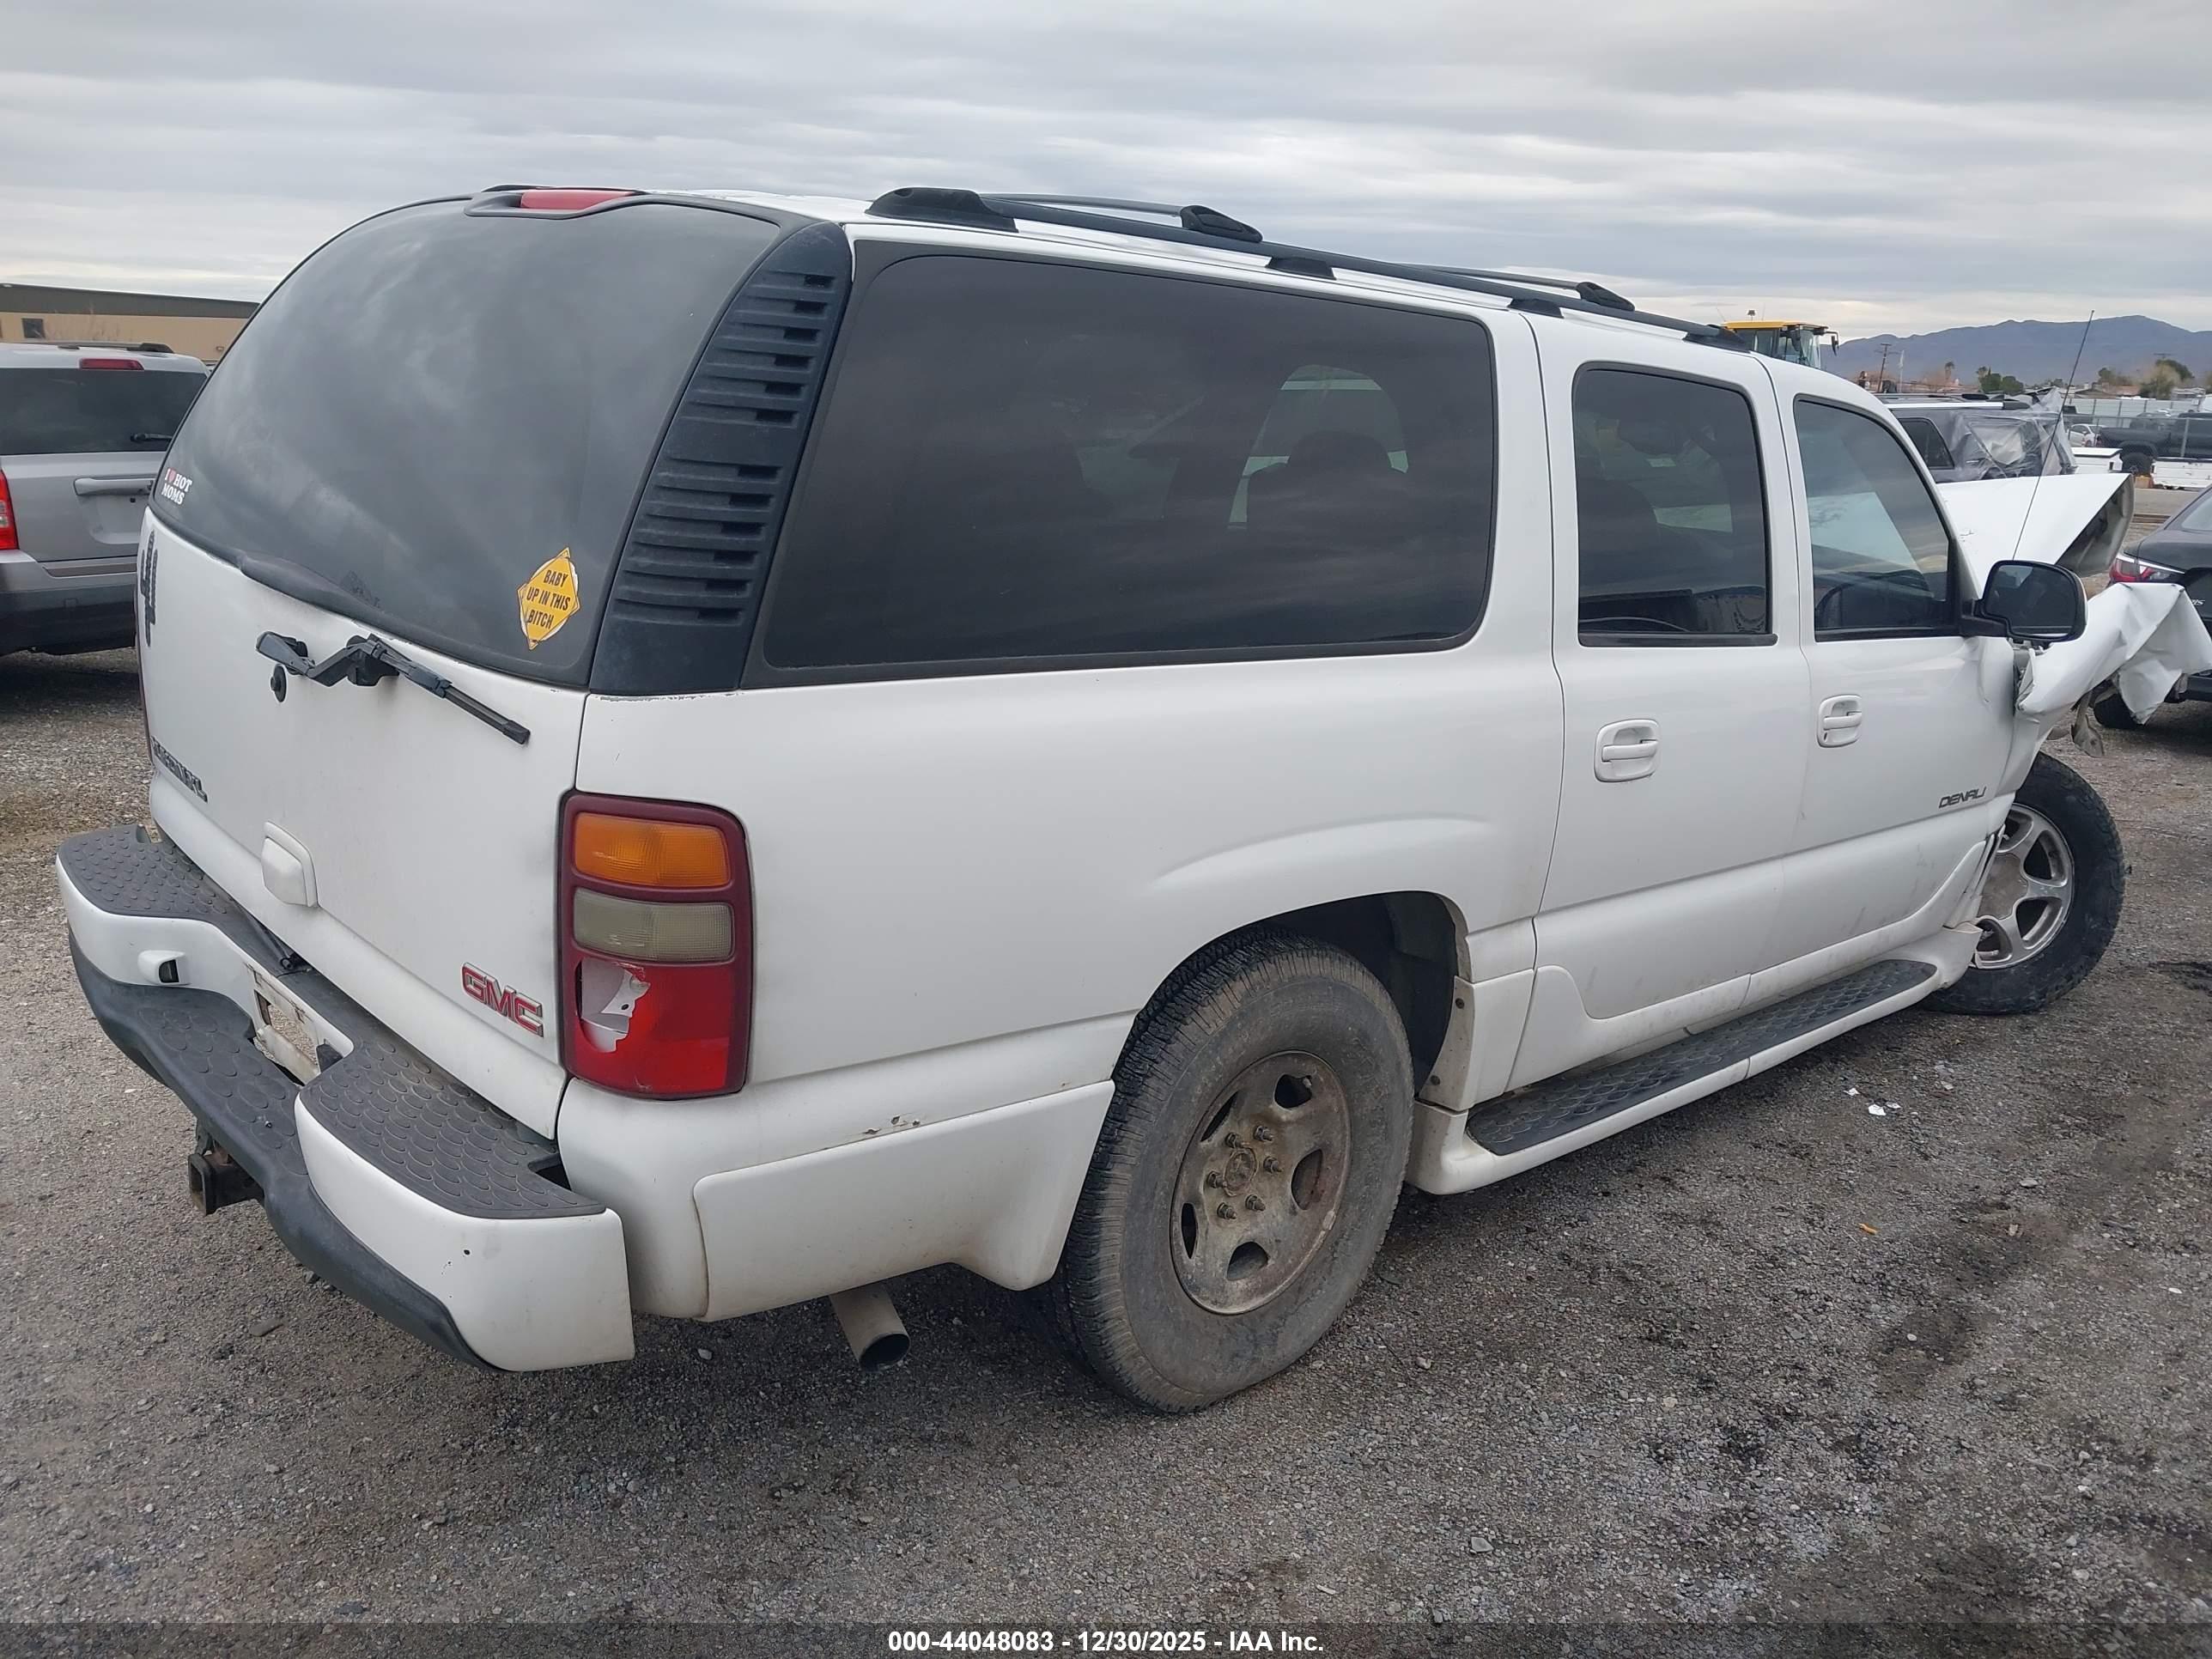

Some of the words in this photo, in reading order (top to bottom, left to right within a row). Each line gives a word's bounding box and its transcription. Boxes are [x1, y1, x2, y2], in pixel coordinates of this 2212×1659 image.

[164, 468, 171, 481] I
[173, 473, 192, 493] HOT
[161, 483, 185, 505] MOMS
[544, 569, 568, 587] BABY
[526, 586, 540, 602] UP
[538, 591, 550, 605] IN
[550, 593, 571, 611] THIS
[527, 609, 555, 629] BITCH
[1939, 787, 1987, 809] DENALI
[461, 962, 544, 1038] GMC
